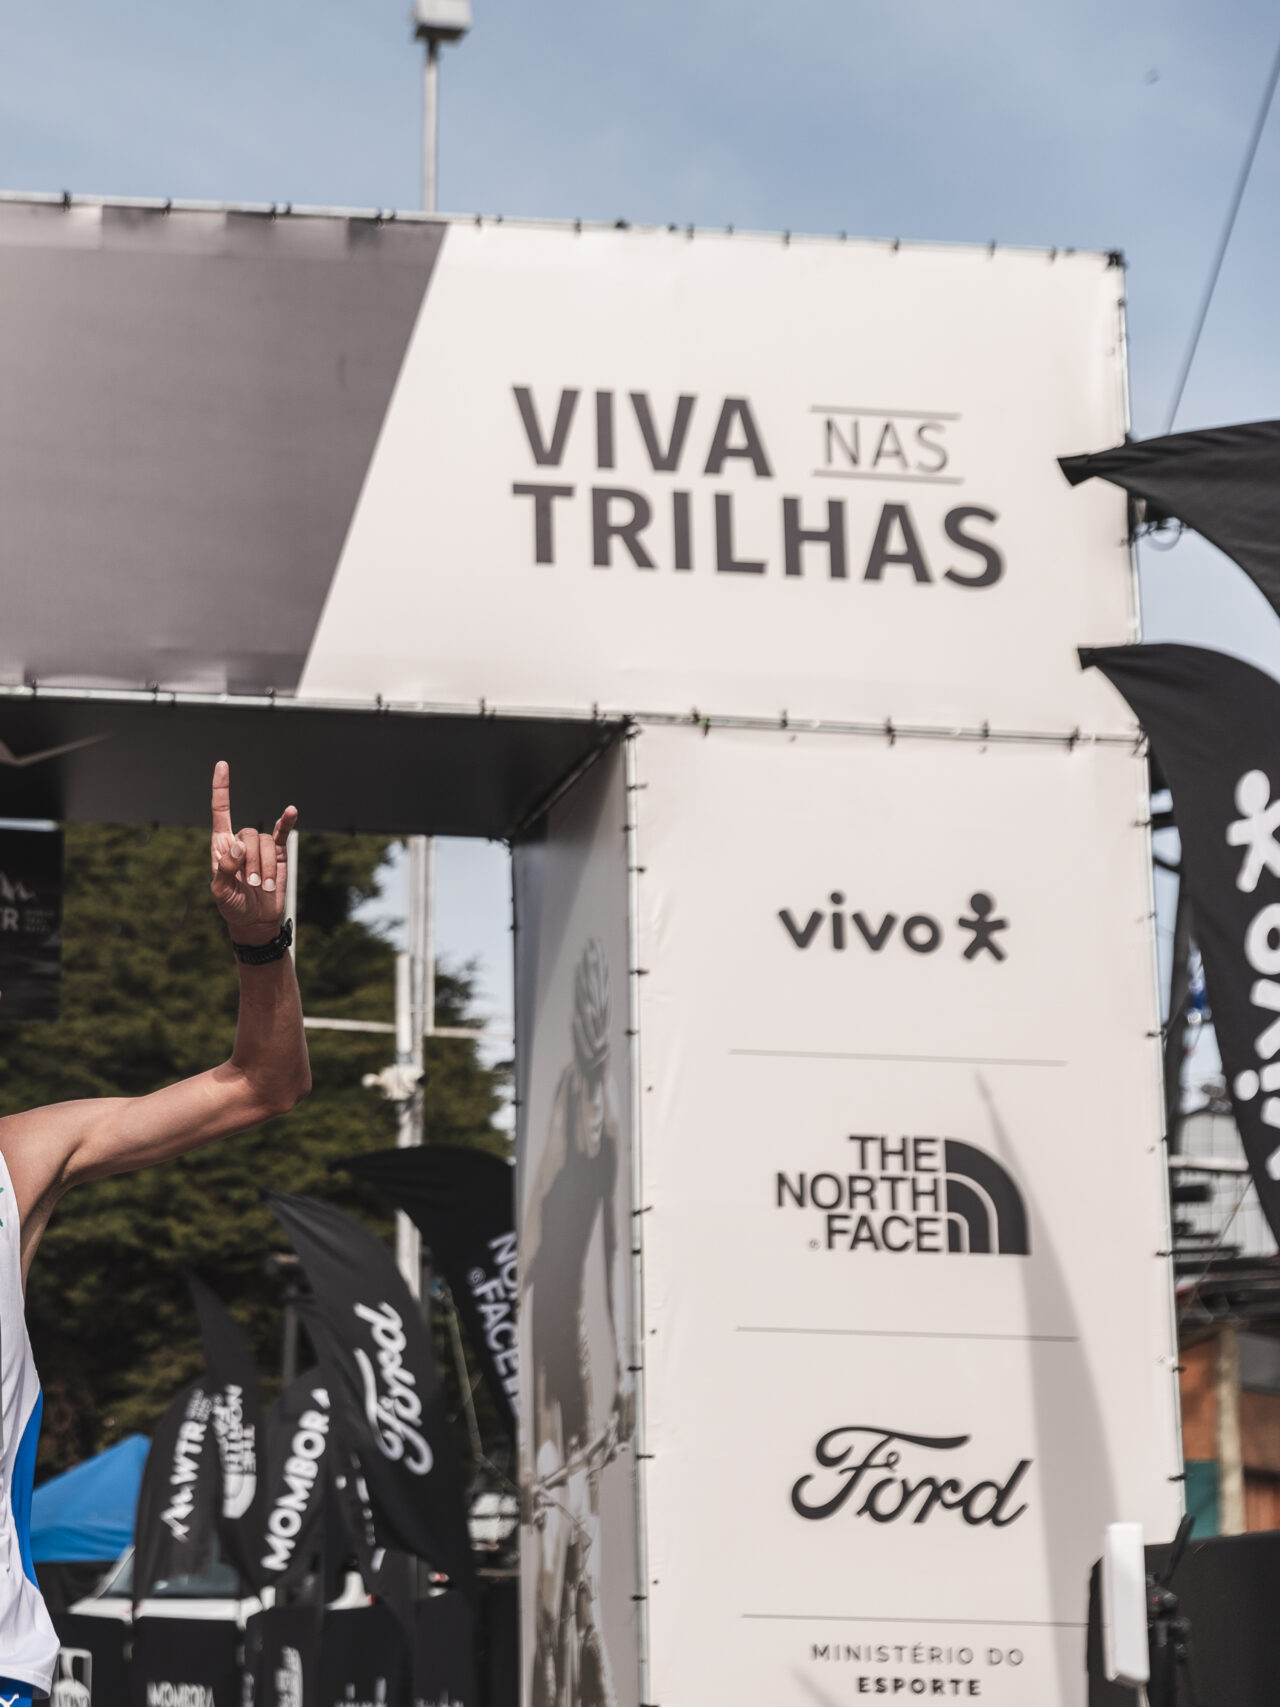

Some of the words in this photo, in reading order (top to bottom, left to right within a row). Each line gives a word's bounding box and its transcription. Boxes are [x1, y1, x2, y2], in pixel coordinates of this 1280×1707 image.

[512, 384, 774, 478] VIVA
[822, 417, 950, 473] NAS
[512, 481, 1007, 590] TRILHAS
[778, 892, 942, 954] vivo
[848, 1134, 940, 1173] THE
[776, 1171, 940, 1213] NORTH
[825, 1214, 941, 1254] FACE
[353, 1301, 434, 1476] Ford
[790, 1425, 1034, 1527] Ford
[812, 1642, 975, 1666] MINISTÉRIO
[987, 1647, 1025, 1667] DO
[857, 1676, 982, 1696] ESPORTE
